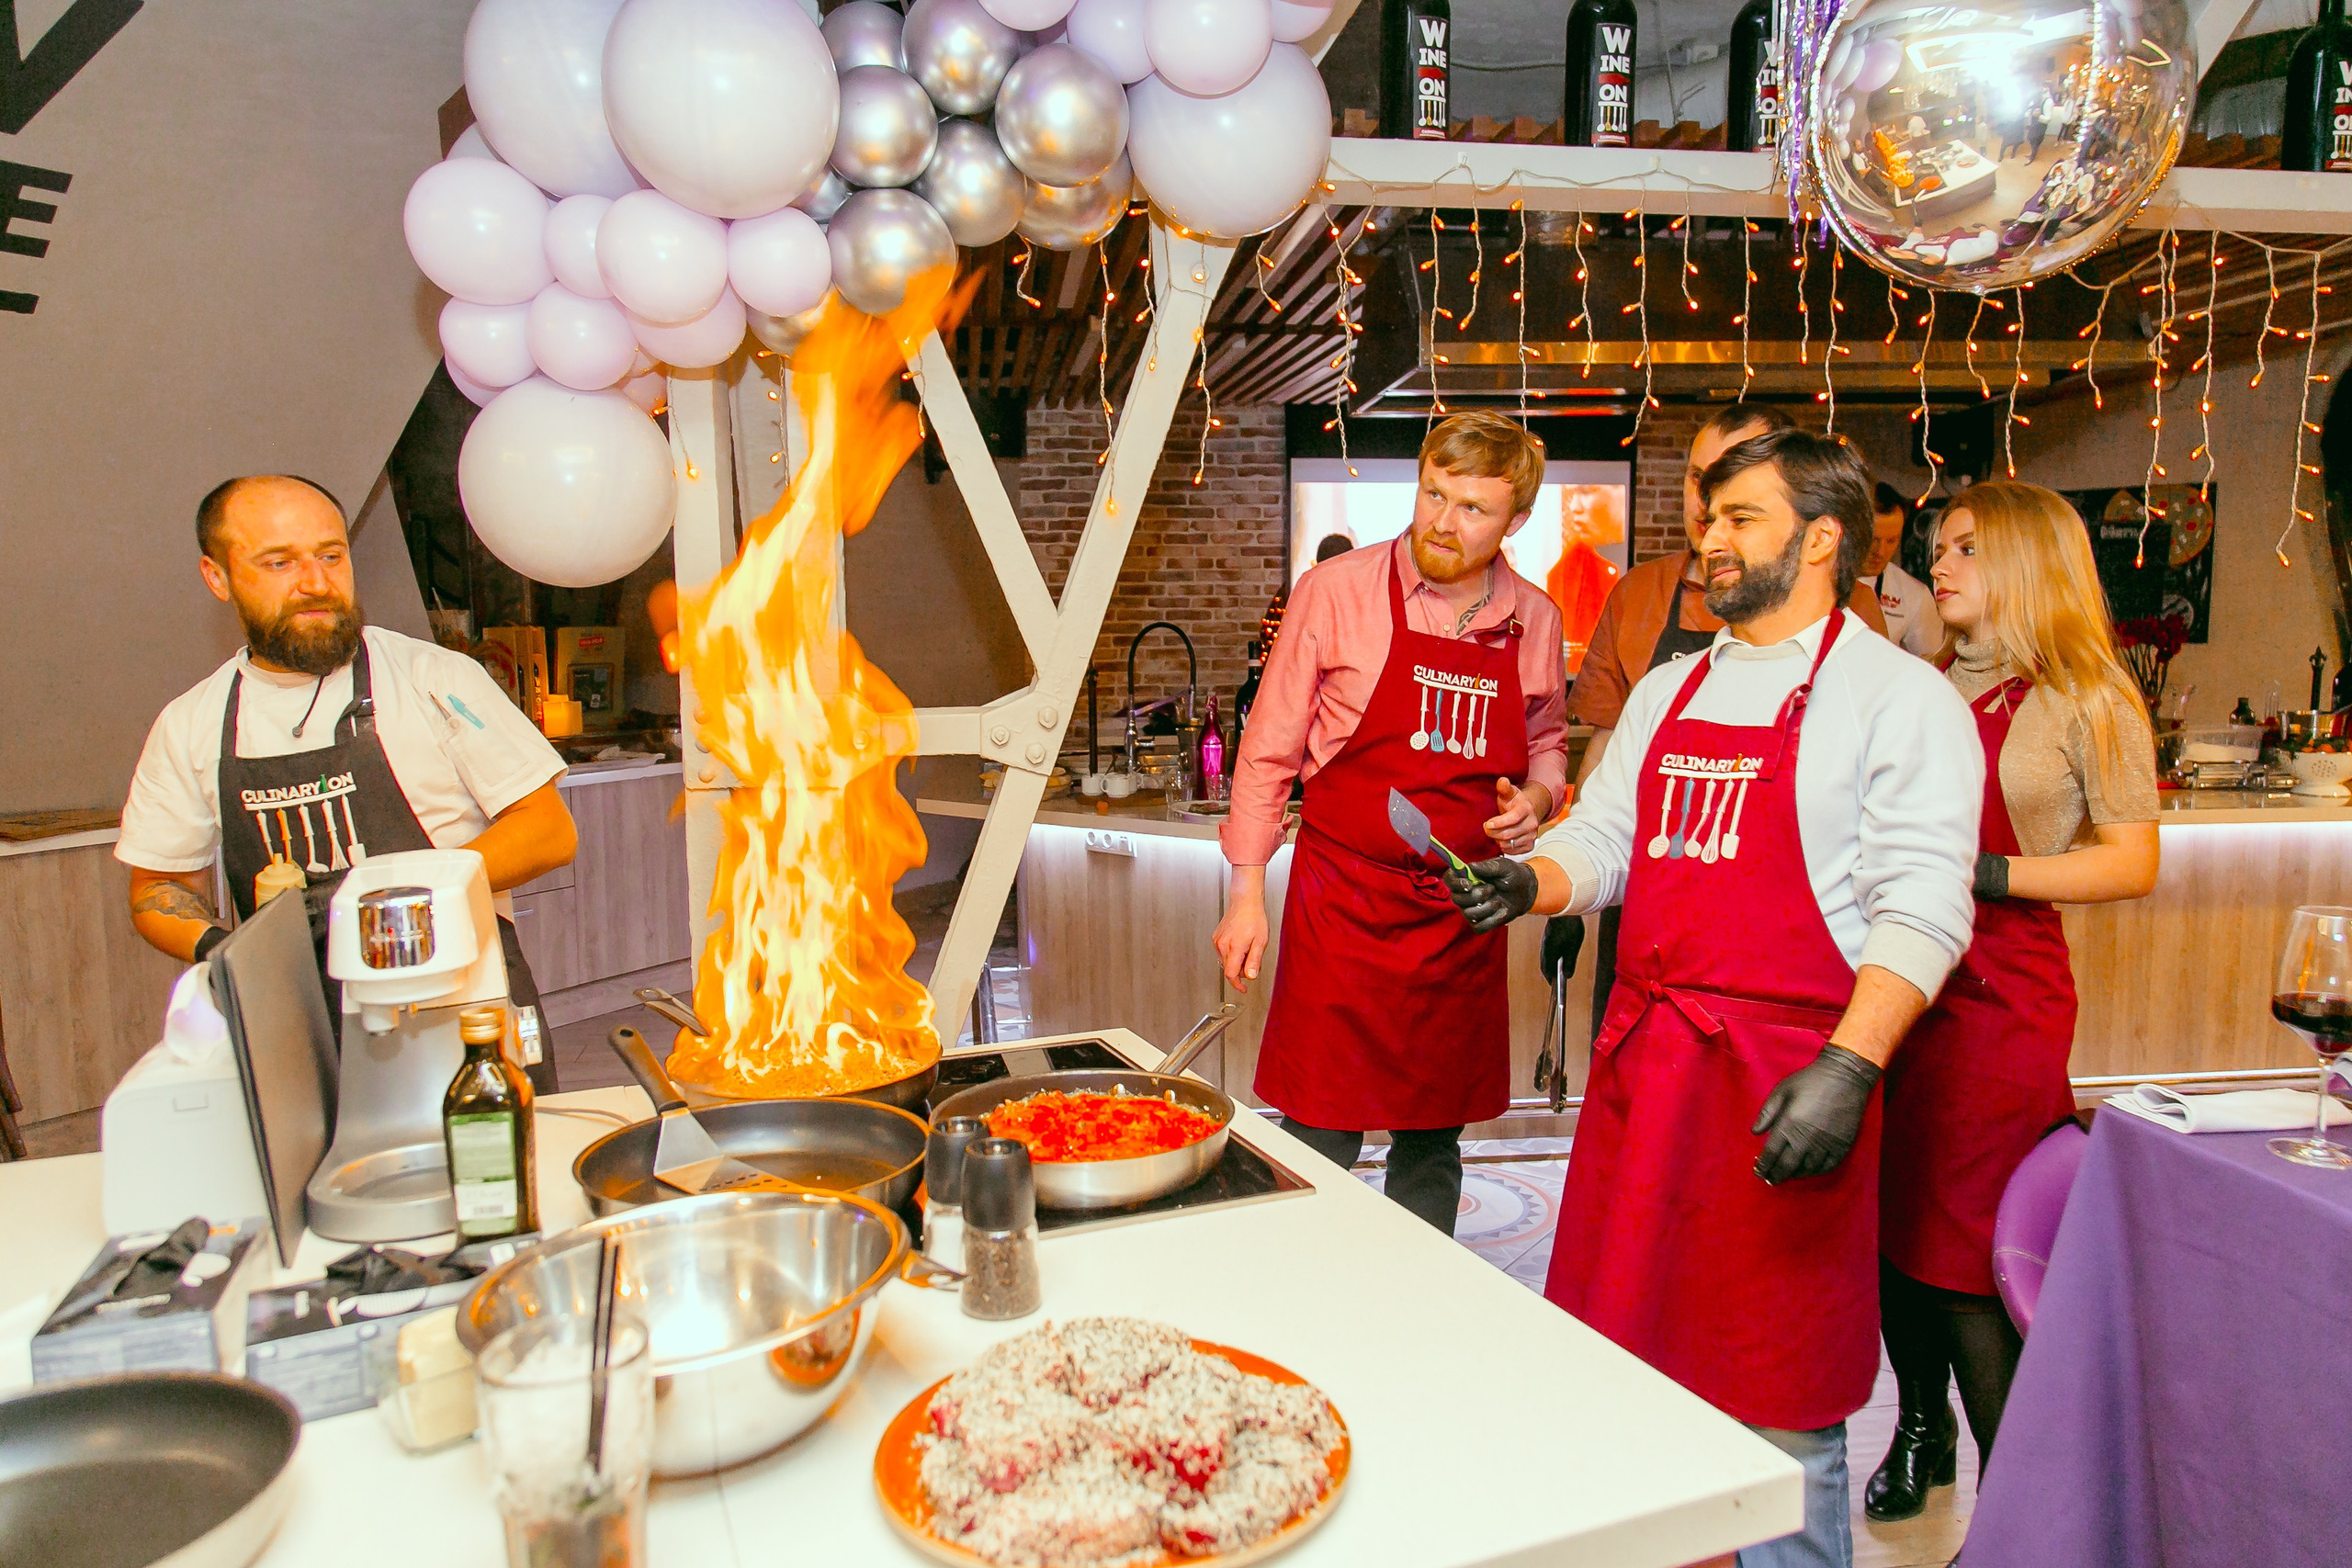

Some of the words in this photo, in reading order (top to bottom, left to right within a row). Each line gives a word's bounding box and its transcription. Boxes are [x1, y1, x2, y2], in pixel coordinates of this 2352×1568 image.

[1419, 18, 1447, 48] W
[1601, 26, 1632, 54] W
[1419, 48, 1447, 69] INE
[1600, 55, 1631, 73] INE
[1419, 77, 1446, 97] ON
[1599, 84, 1628, 102] ON
